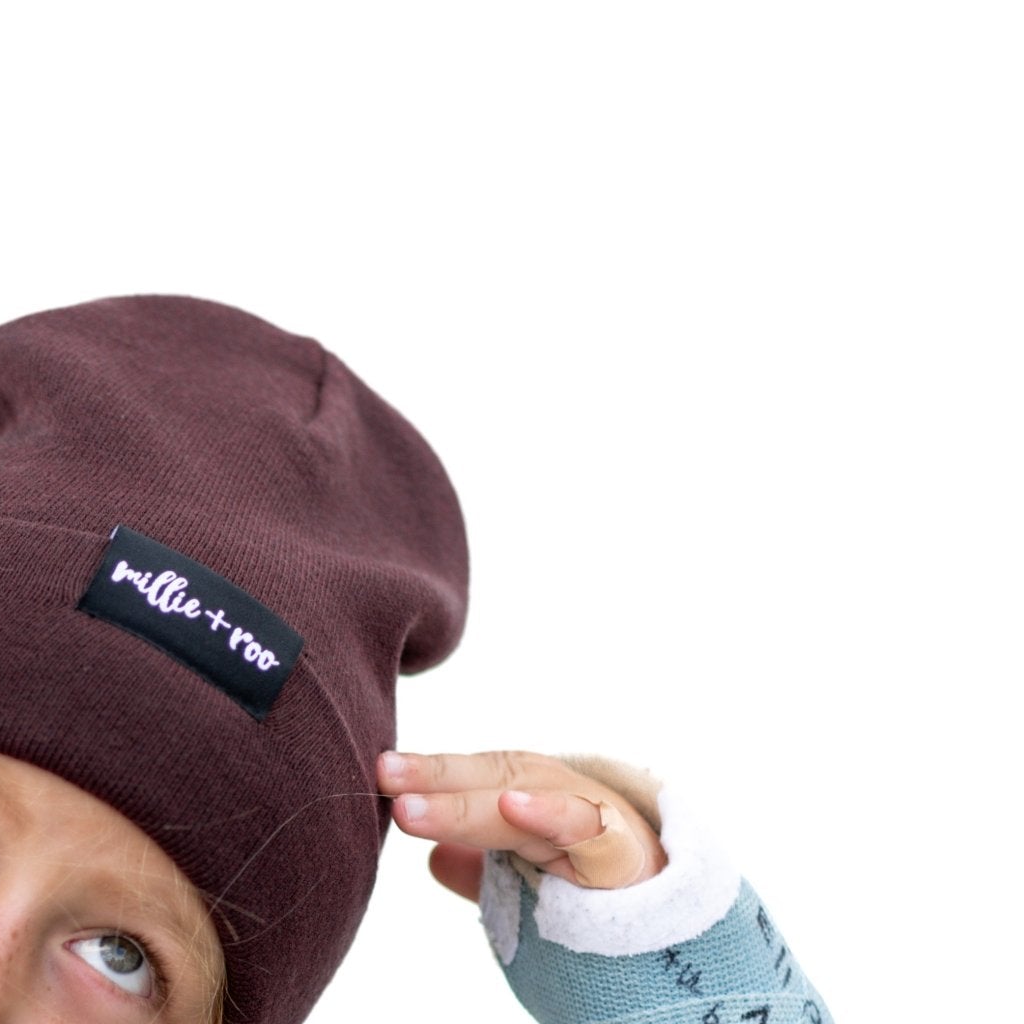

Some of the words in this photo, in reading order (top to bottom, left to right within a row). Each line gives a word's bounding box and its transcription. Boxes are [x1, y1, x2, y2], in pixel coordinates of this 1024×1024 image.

[110, 560, 202, 619] millie
[205, 609, 232, 631] +
[229, 627, 280, 671] roo
